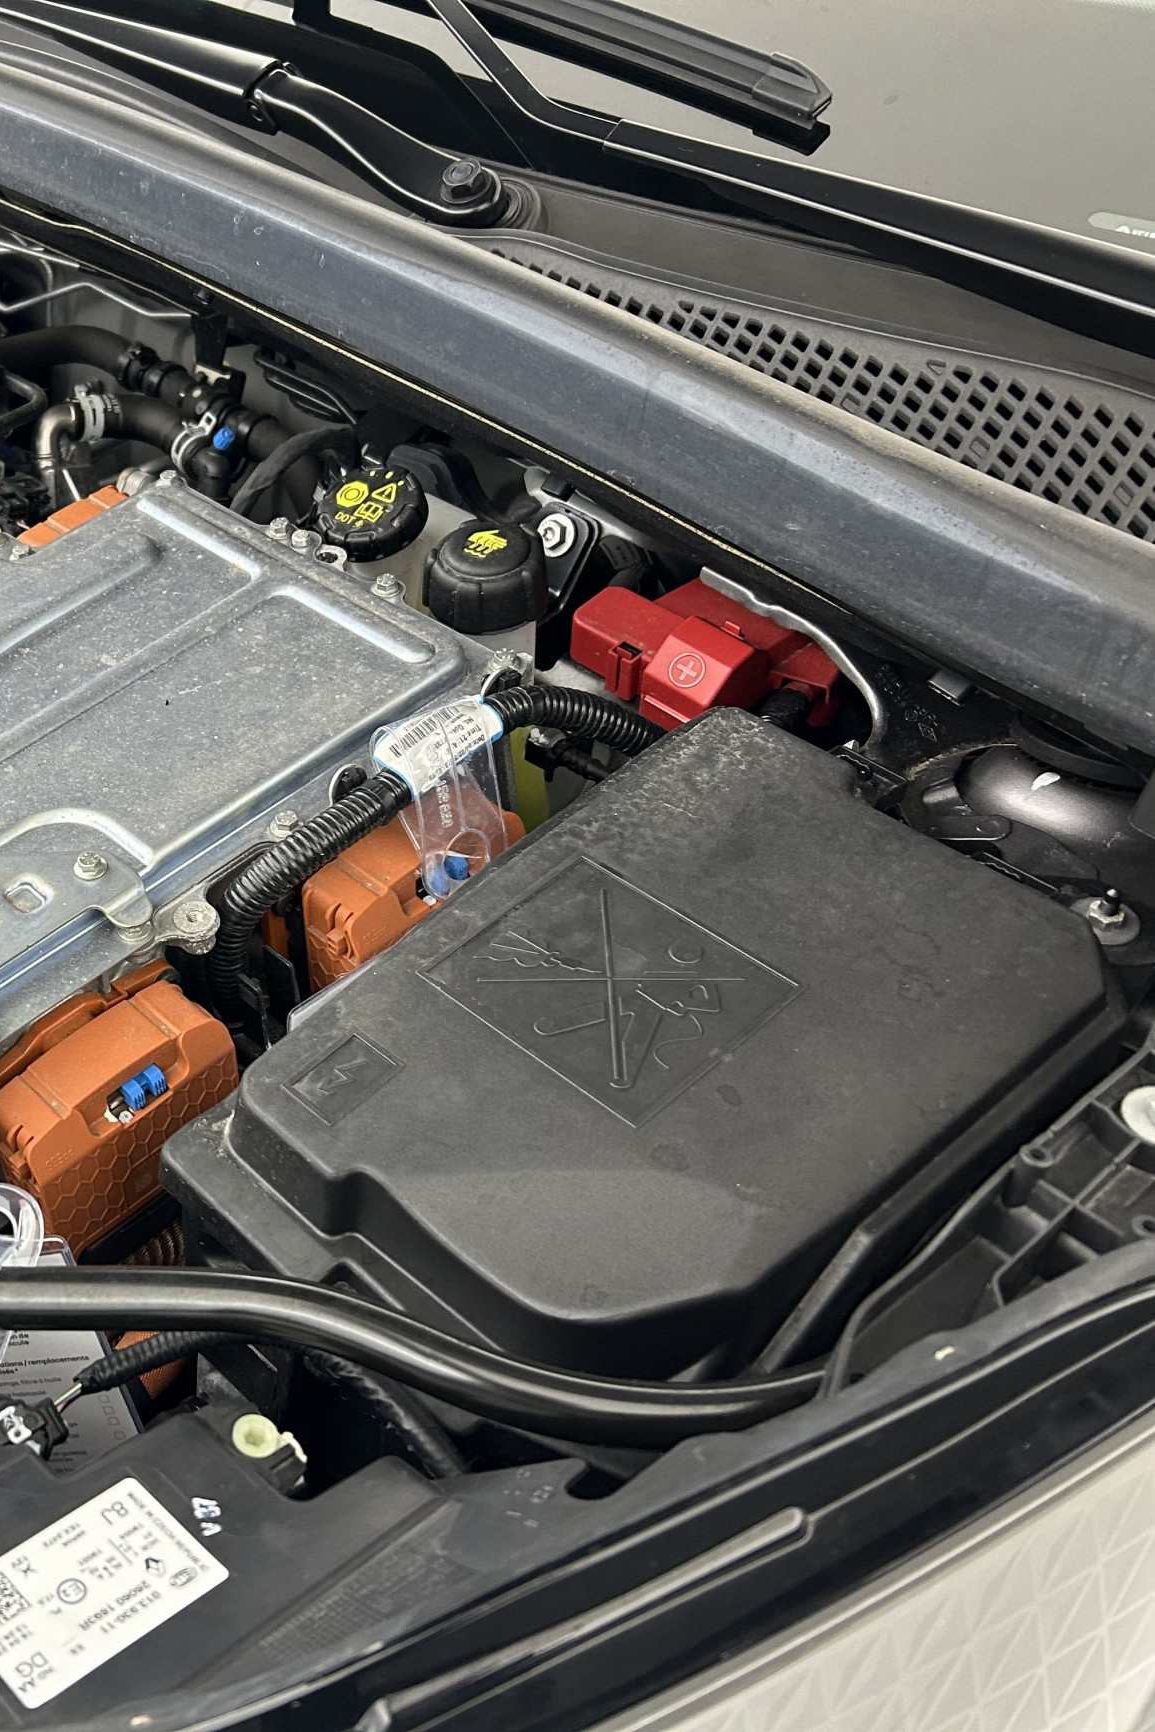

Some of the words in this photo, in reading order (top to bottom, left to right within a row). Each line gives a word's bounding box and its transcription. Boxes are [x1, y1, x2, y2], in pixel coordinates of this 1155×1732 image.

[335, 511, 354, 524] DOT
[353, 520, 364, 528] 4
[100, 1500, 128, 1524] 8J
[12, 1650, 49, 1679] DG
